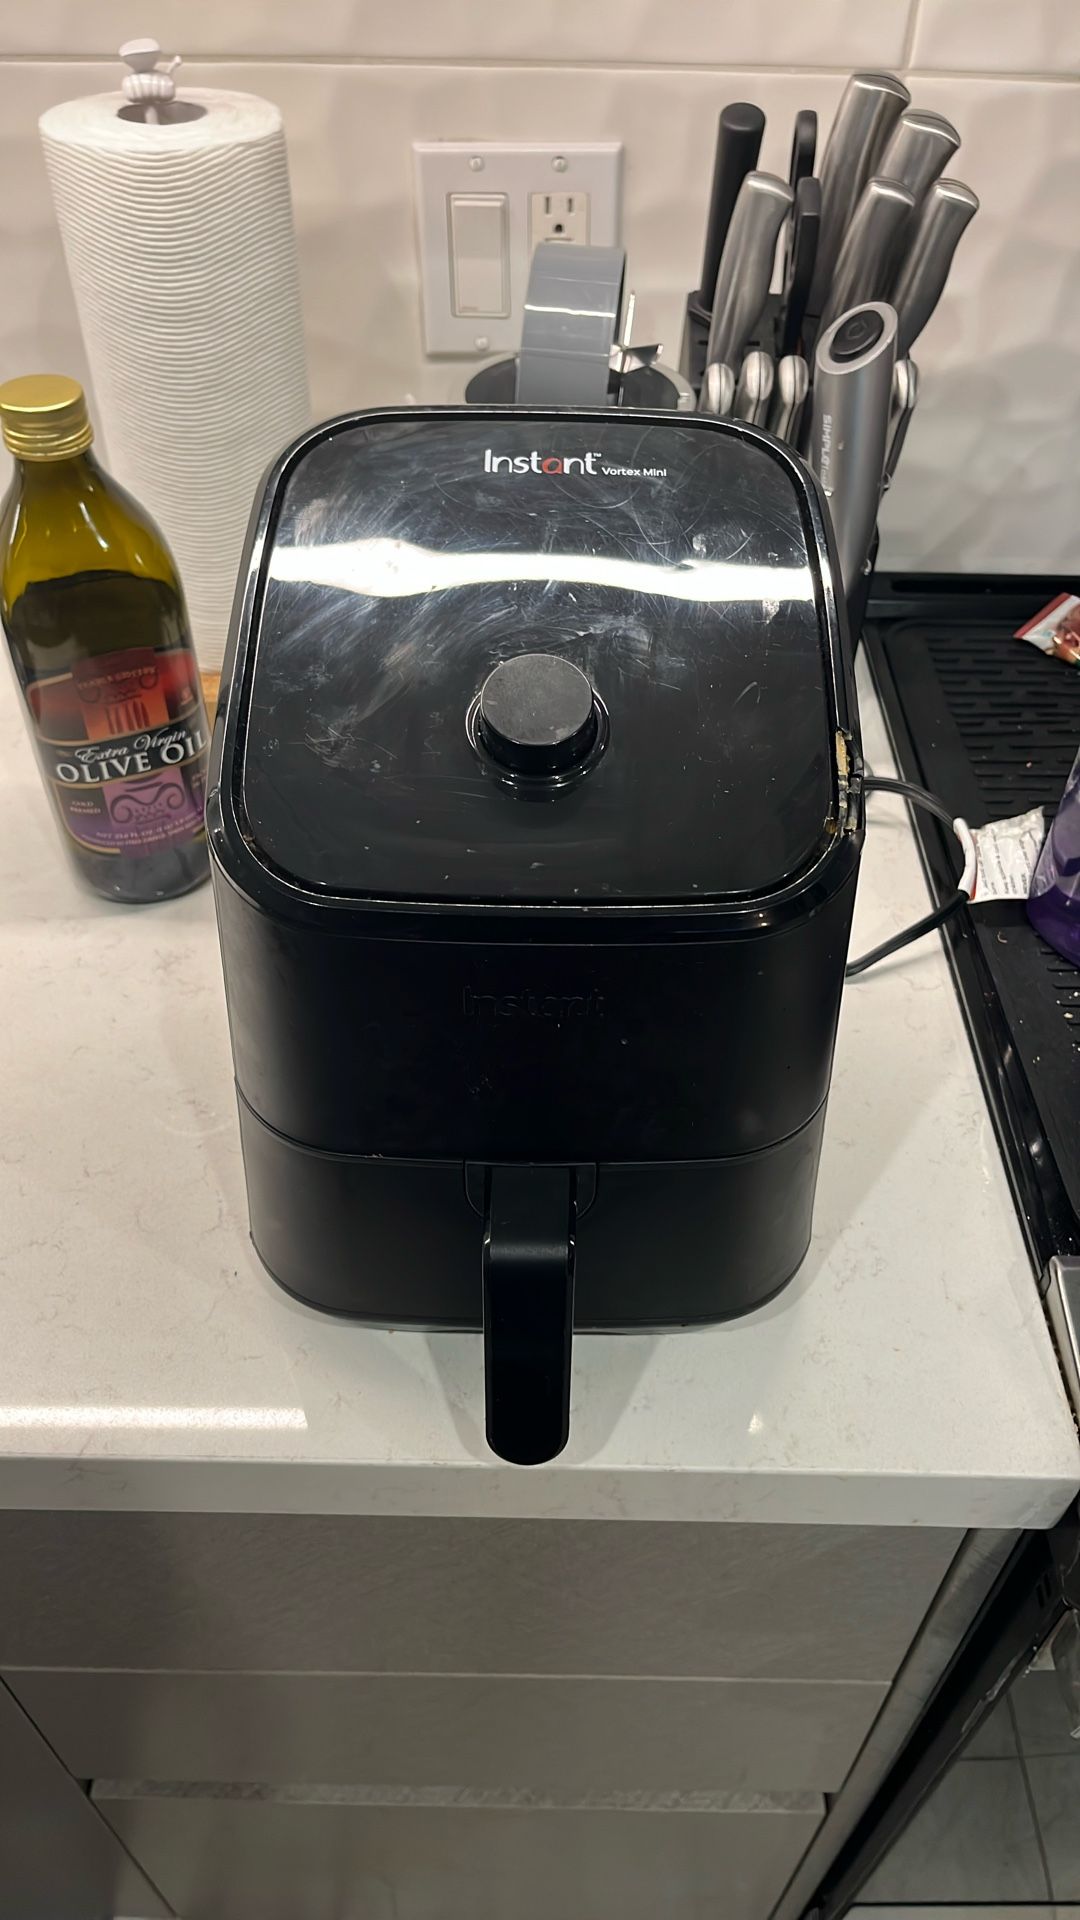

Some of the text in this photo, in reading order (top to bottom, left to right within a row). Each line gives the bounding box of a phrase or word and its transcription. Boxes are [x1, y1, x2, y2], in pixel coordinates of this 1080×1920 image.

[602, 466, 641, 477] Vortex
[643, 467, 667, 477] Mini
[56, 752, 152, 783] OLIVE
[160, 729, 207, 764] OIL
[74, 727, 187, 764] Extra Virgin
[463, 985, 604, 1017] Instant
